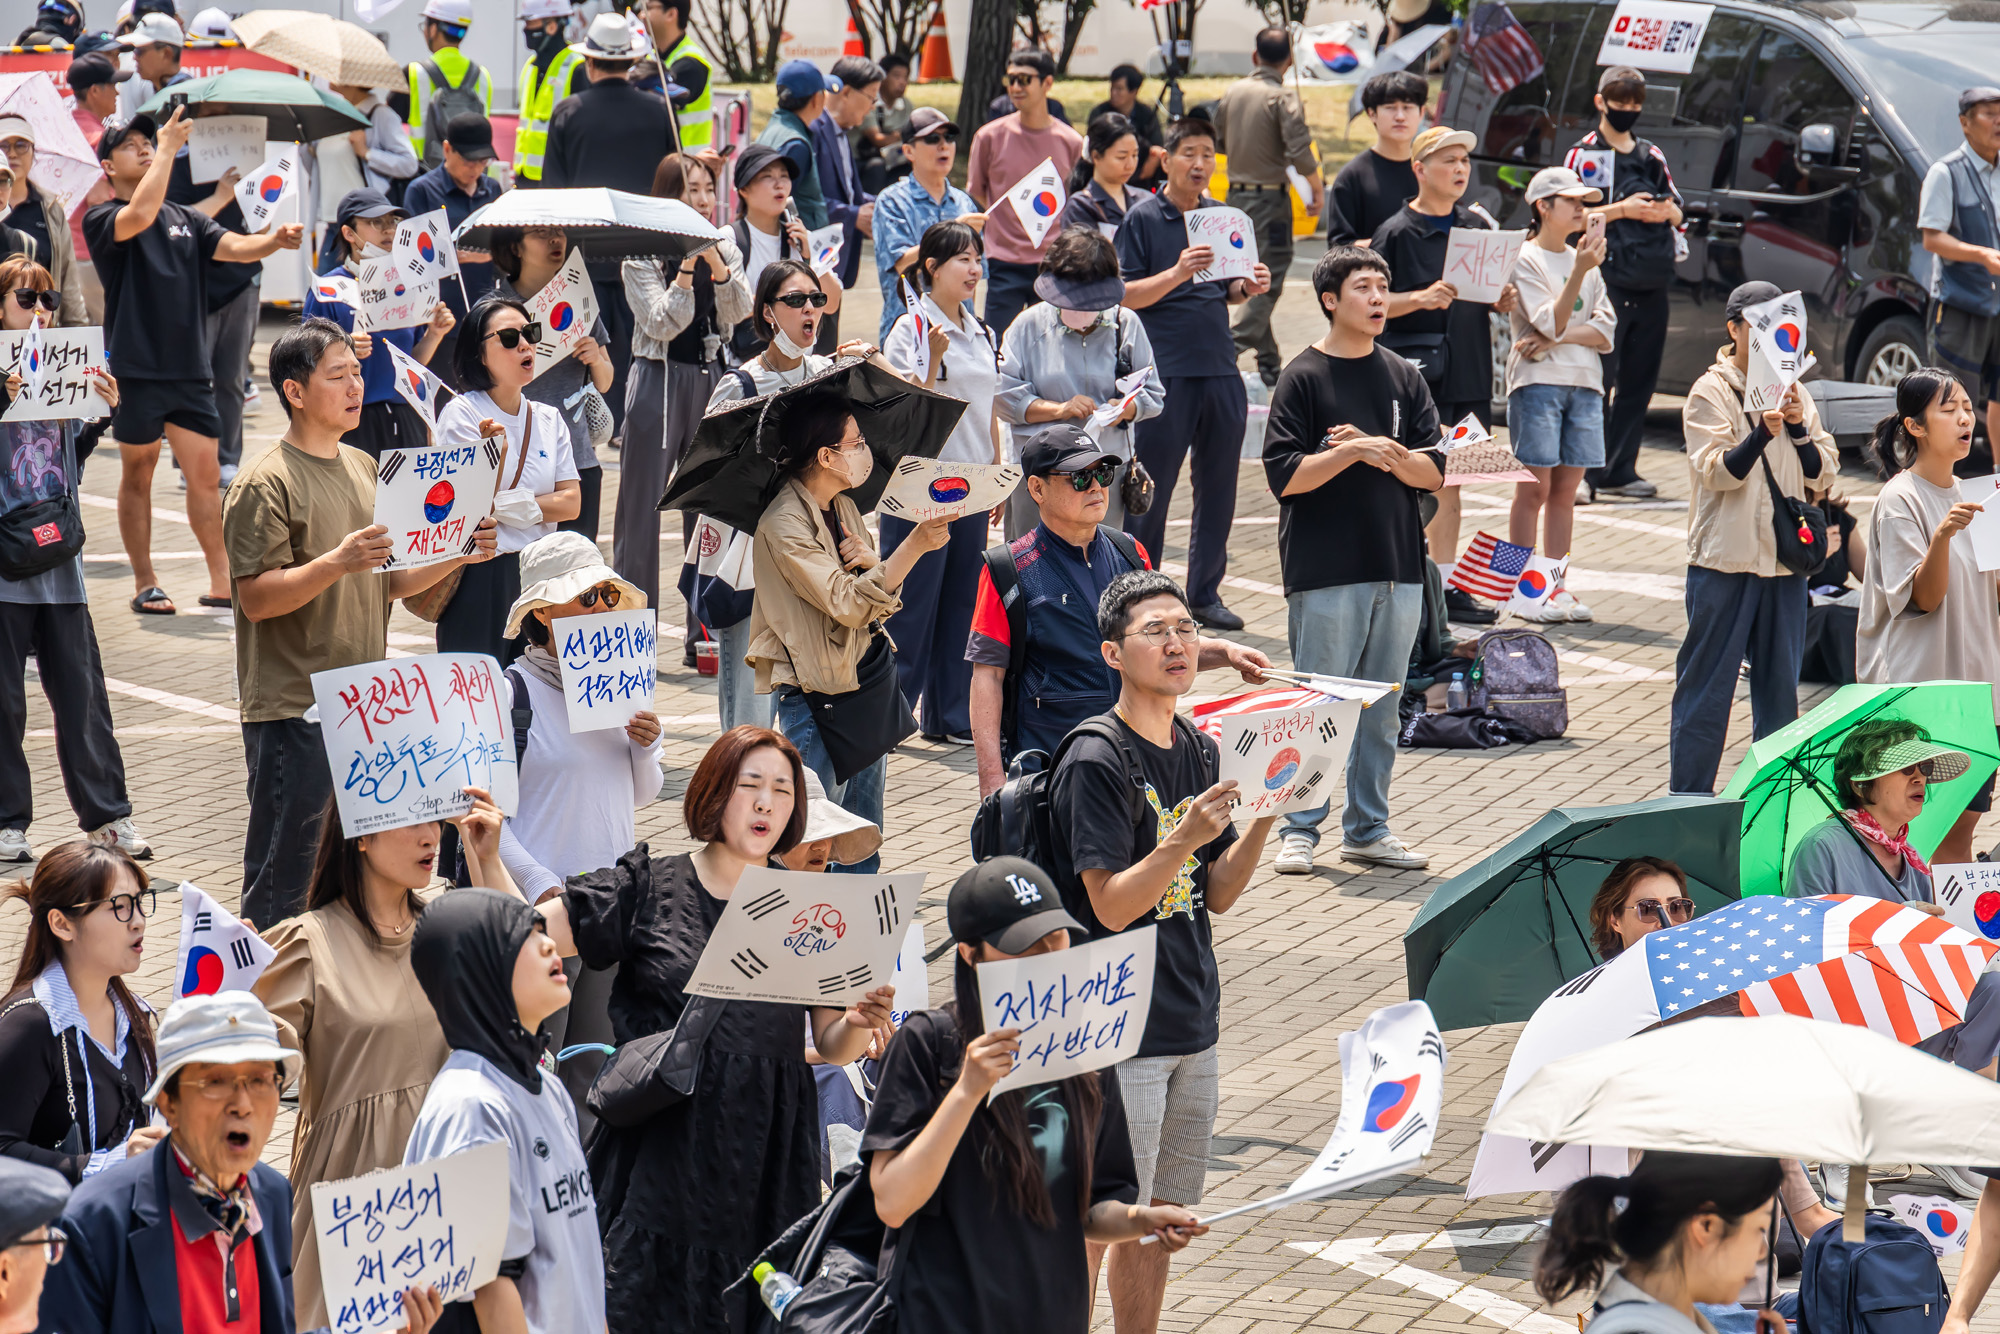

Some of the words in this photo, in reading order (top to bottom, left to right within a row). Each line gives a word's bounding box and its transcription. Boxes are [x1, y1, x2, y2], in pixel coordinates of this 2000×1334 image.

[536, 273, 569, 313] 당일투표
[559, 317, 587, 349] 수개표
[413, 445, 477, 480] 부정선거
[933, 464, 987, 477] 부정선거
[406, 515, 466, 556] 재선거
[337, 662, 440, 745] 부정선거
[443, 660, 505, 741] 재선거
[1260, 710, 1316, 747] 부정선거
[344, 733, 453, 805] 당일투표
[434, 721, 516, 787] 수개표
[408, 794, 444, 815] Stop
[449, 788, 471, 804] the
[1005, 874, 1042, 906] LA
[788, 903, 846, 939] STOP
[810, 924, 824, 935] THE
[783, 931, 838, 957] STEAL
[995, 953, 1136, 1034] 전자개표
[326, 1172, 442, 1248] 부정선거
[355, 1225, 454, 1287] 재선거
